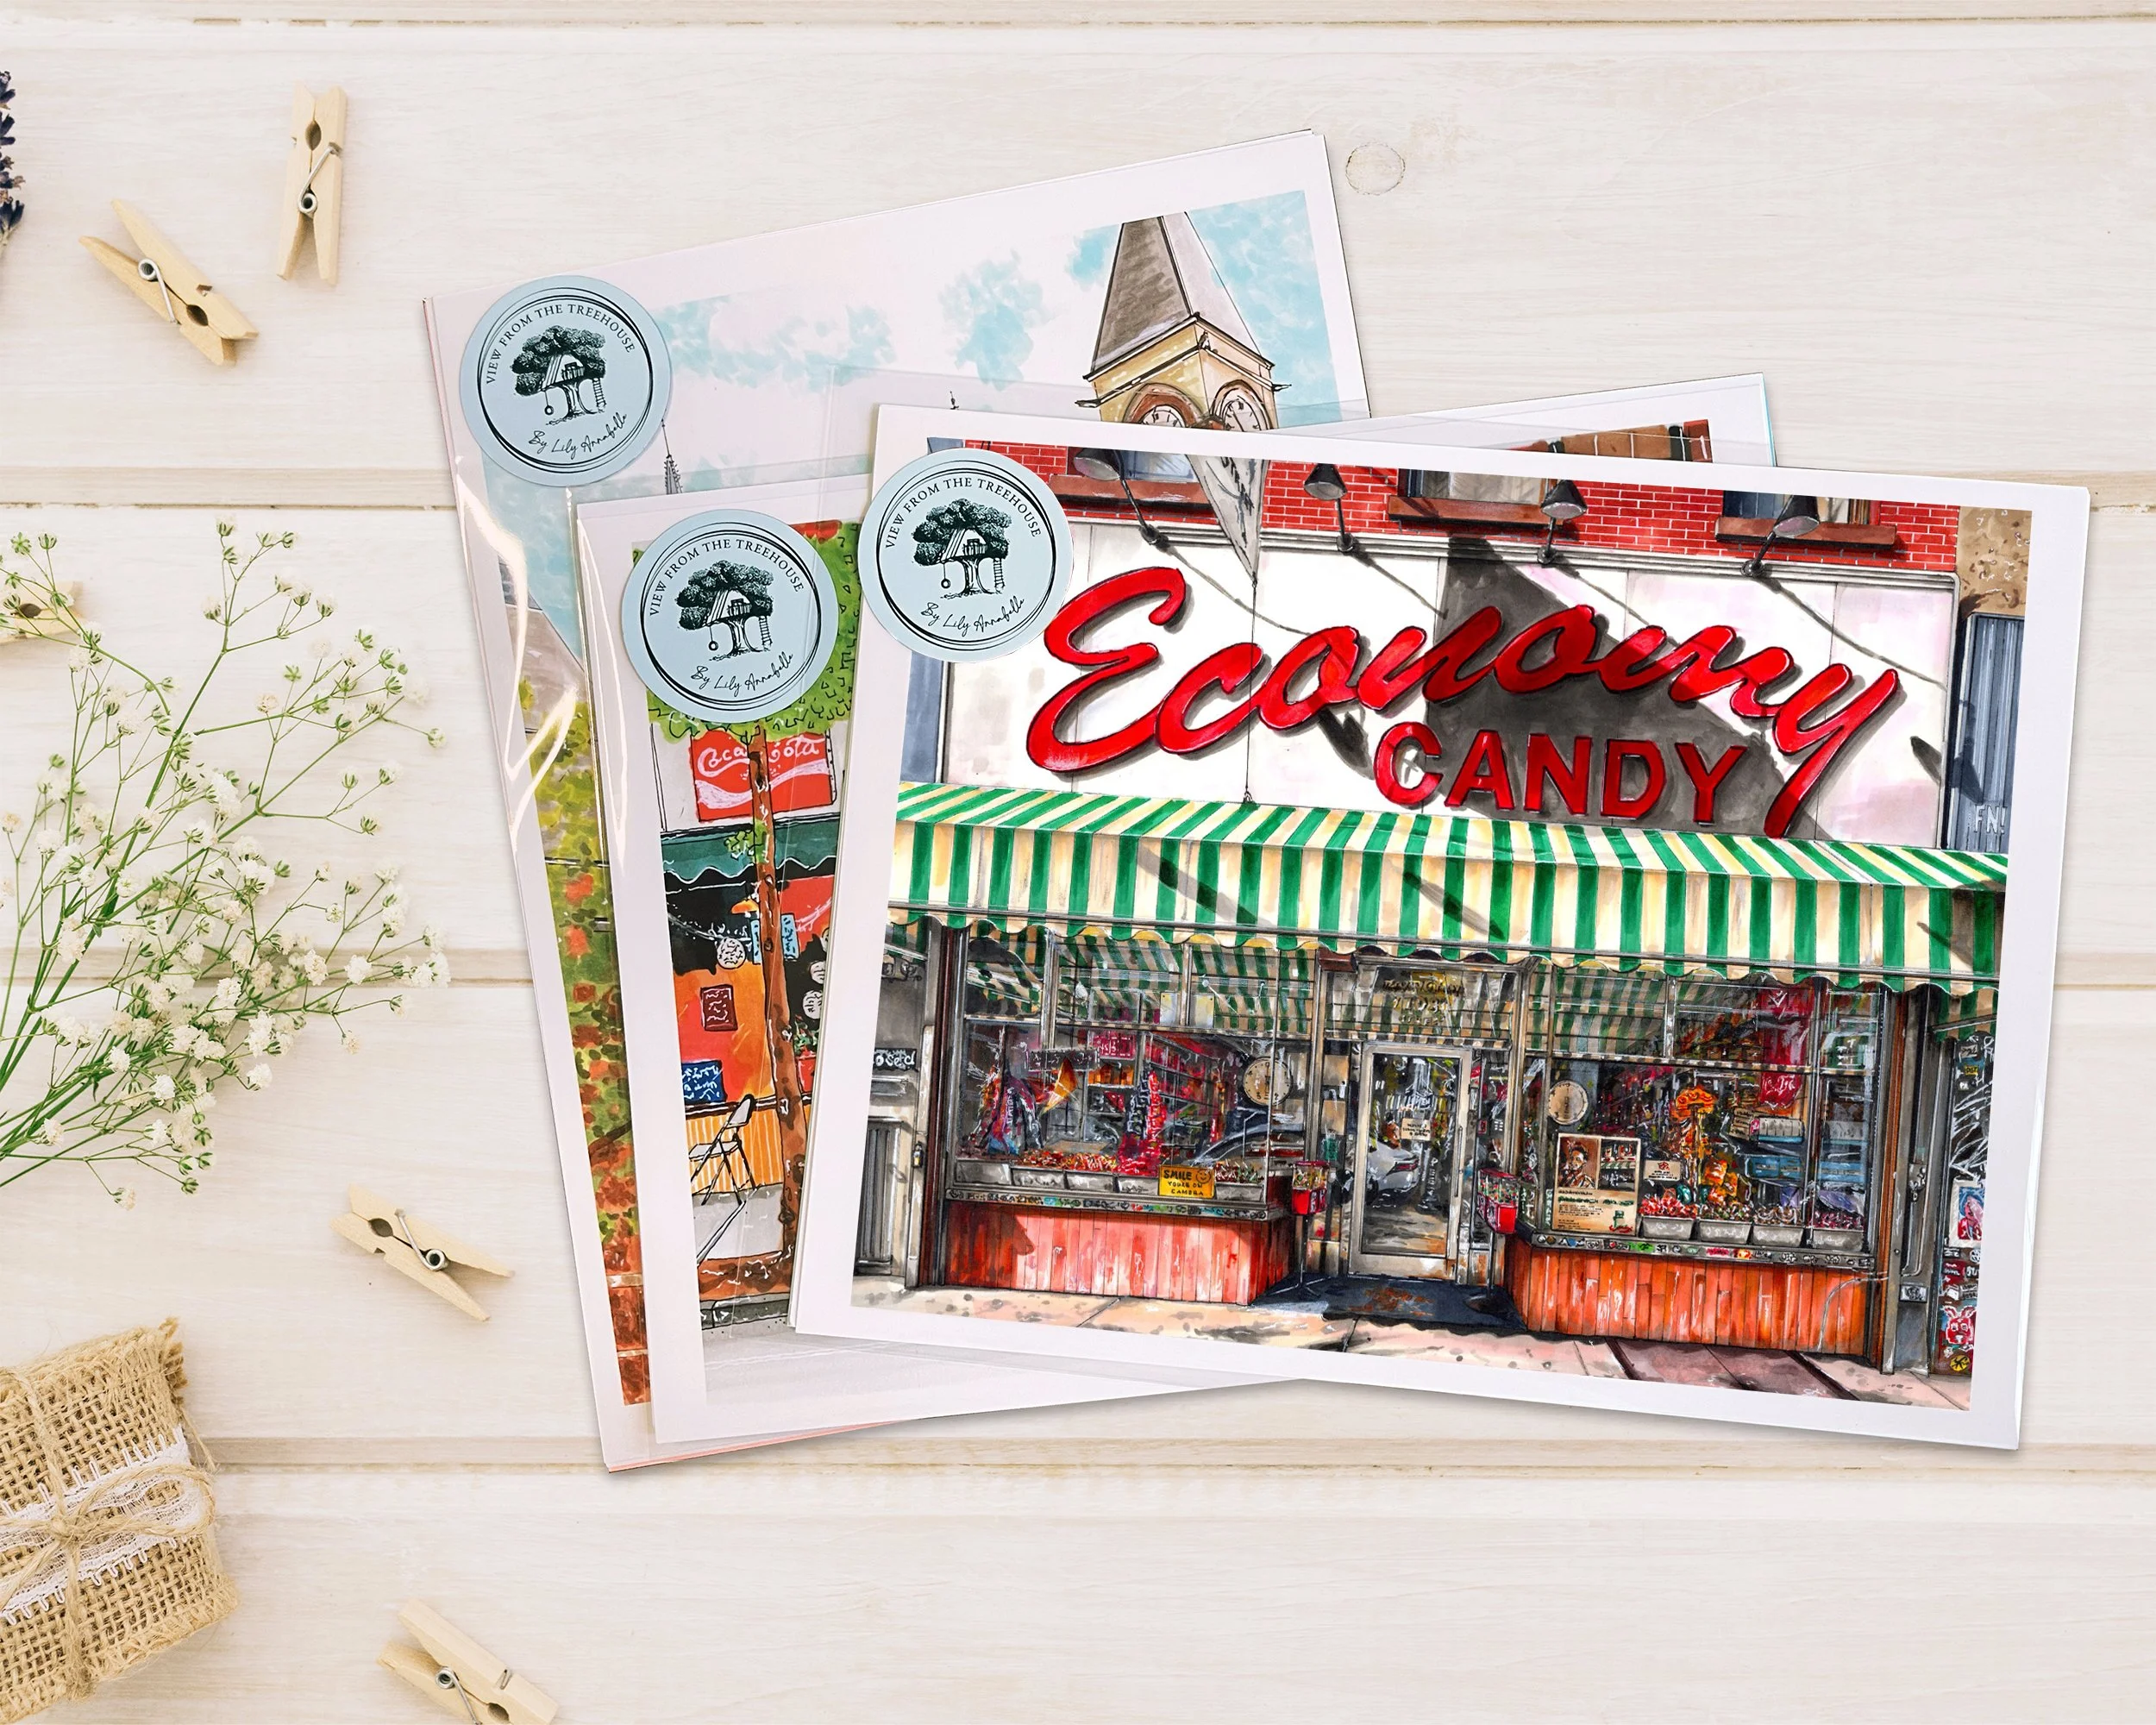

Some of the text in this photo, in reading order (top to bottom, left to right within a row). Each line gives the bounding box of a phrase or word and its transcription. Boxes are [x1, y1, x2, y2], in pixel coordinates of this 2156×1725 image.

[486, 304, 636, 385] VIEW FROM THE TREEHOUSE
[529, 412, 628, 460] By Lily Annabelle
[886, 477, 1042, 549] VIEW FROM THE TREEHOUSE
[649, 538, 805, 617] VIEW FROM THE TREEHOUSE
[920, 595, 1025, 637] By Lily Annabelle
[690, 650, 794, 697] By Lily Annabelle
[1026, 567, 1901, 839] Economy
[1375, 723, 1749, 824] CANDY
[1163, 1170, 1193, 1181] SMILE
